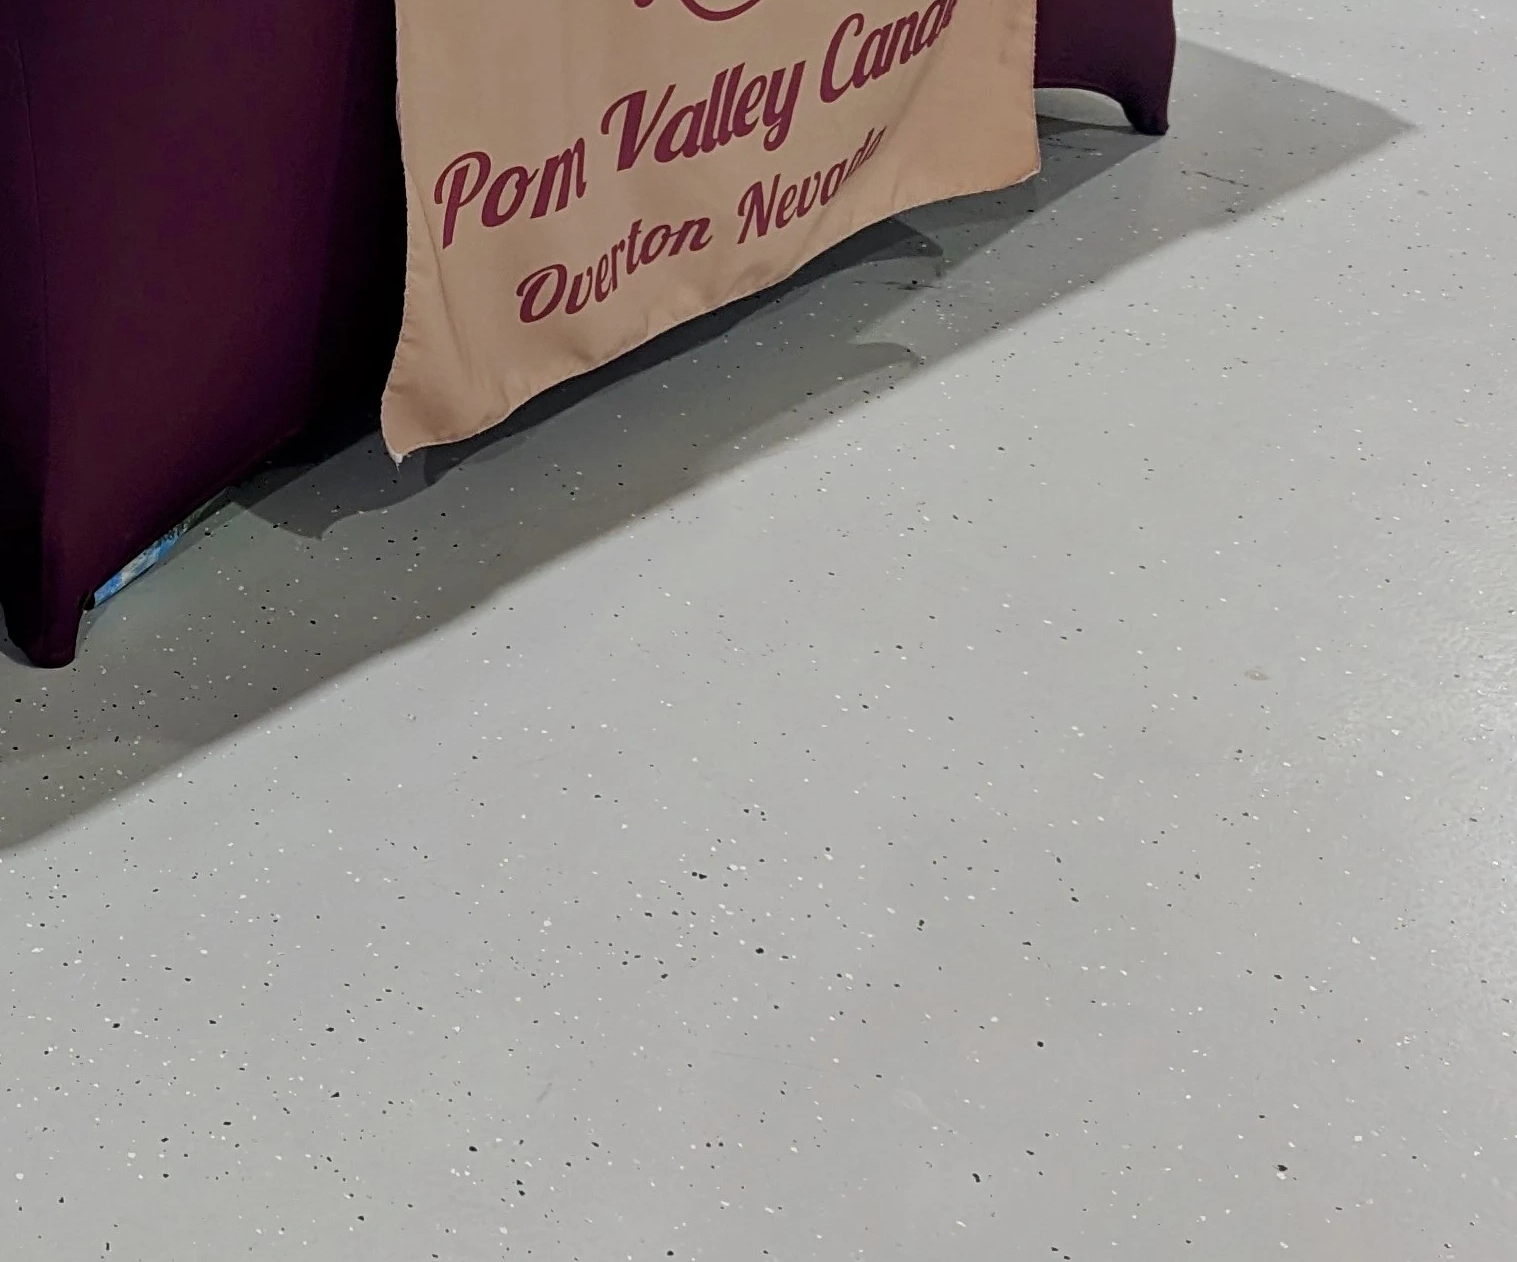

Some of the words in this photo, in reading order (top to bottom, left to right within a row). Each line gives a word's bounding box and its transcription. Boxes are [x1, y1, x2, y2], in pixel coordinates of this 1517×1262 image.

[434, 139, 587, 249] Pom
[601, 59, 806, 171] Valley
[516, 215, 713, 324] Overton
[737, 125, 888, 245] Nevada
